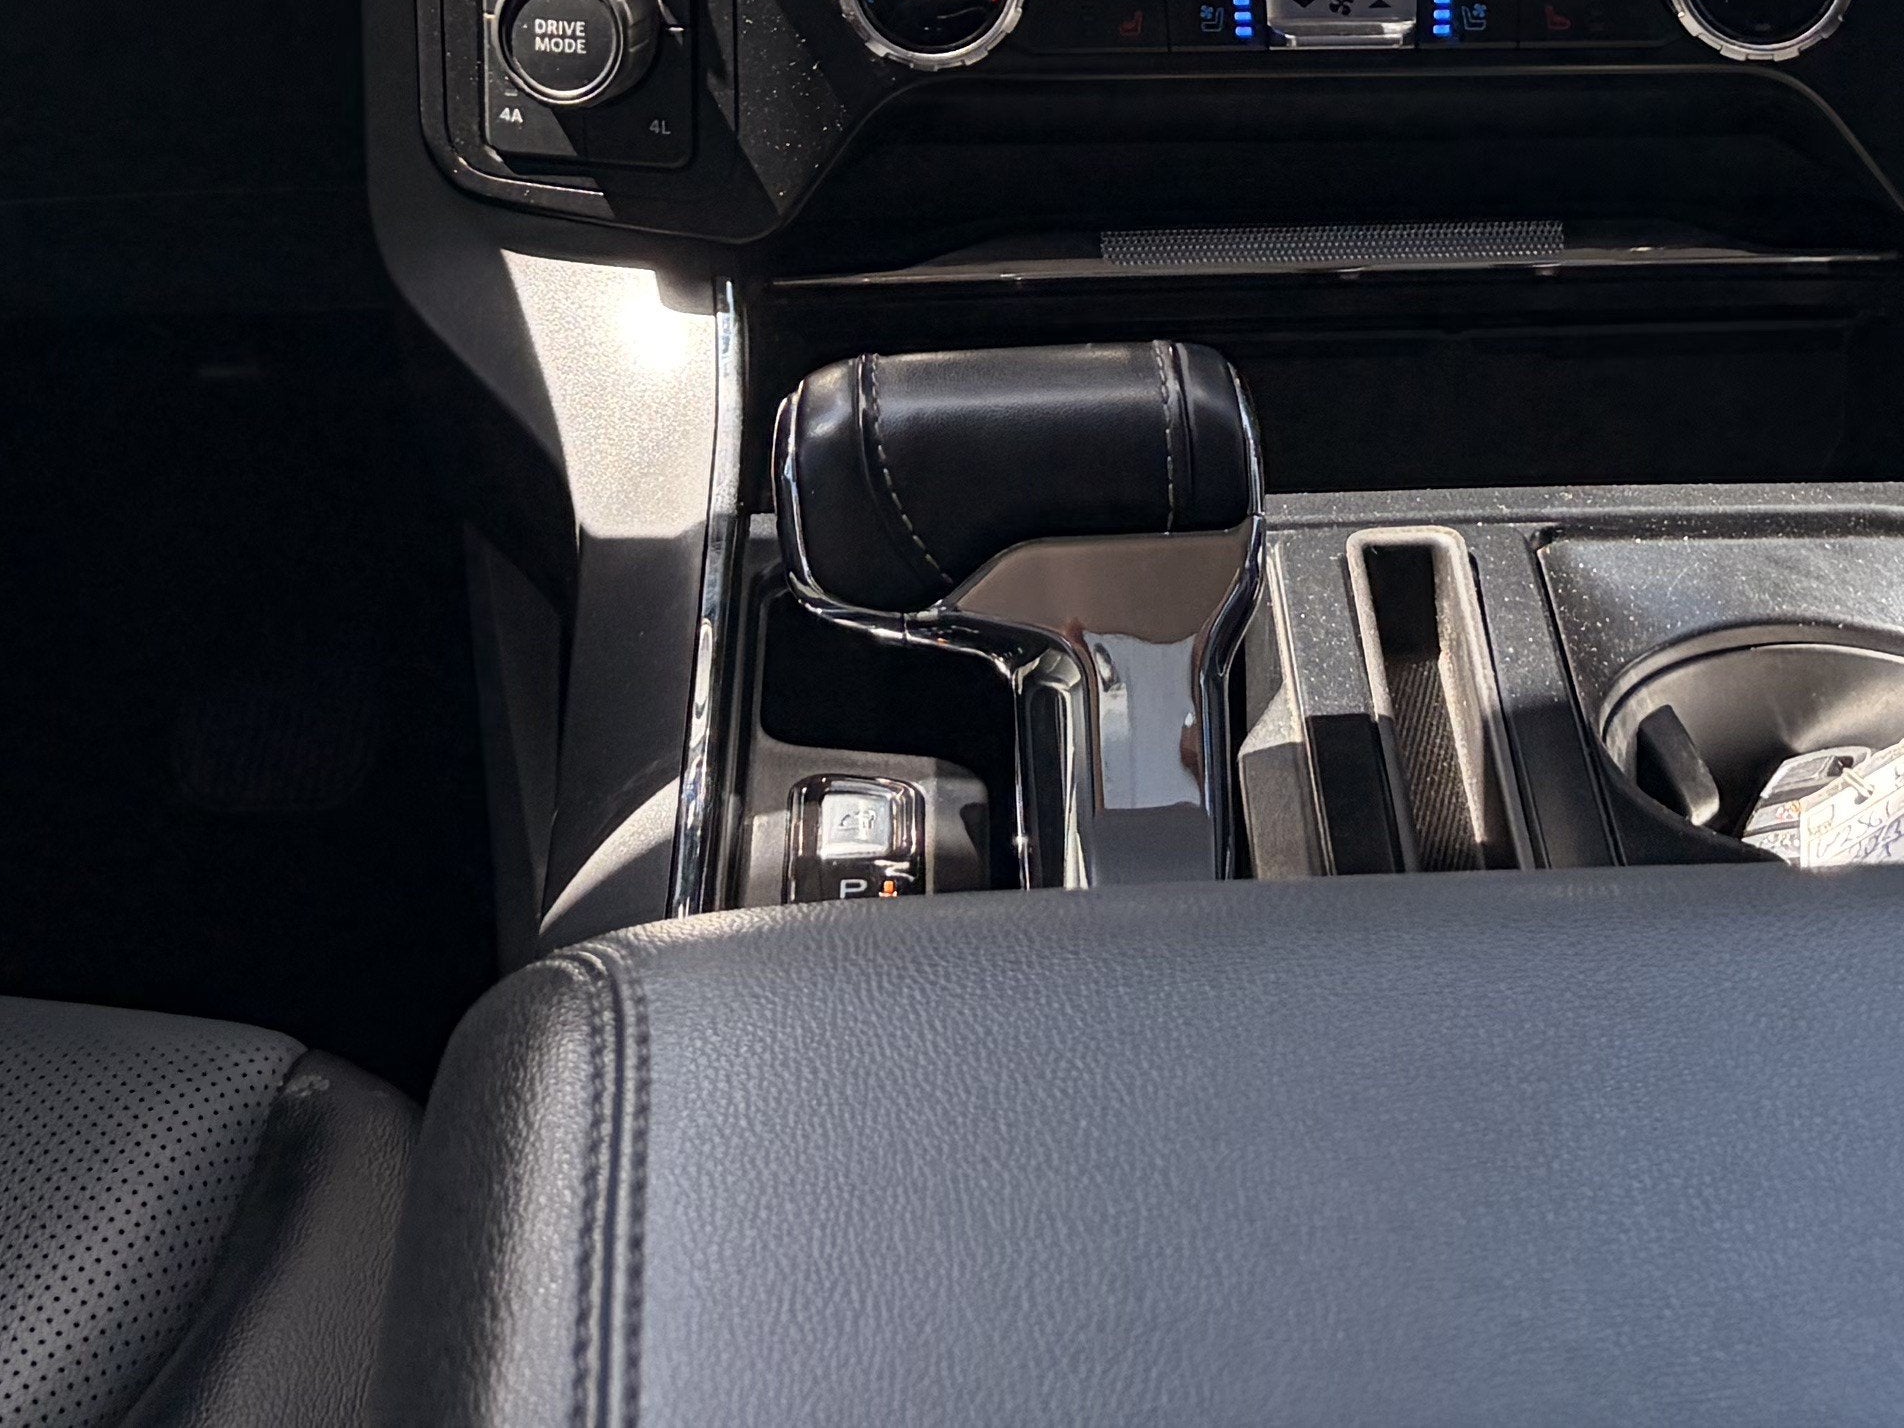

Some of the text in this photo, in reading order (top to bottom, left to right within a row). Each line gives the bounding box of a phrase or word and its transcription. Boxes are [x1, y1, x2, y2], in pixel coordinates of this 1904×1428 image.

[534, 18, 586, 38] DRIVE
[534, 35, 587, 55] MODE
[499, 105, 523, 125] 4A
[648, 118, 670, 137] 4L
